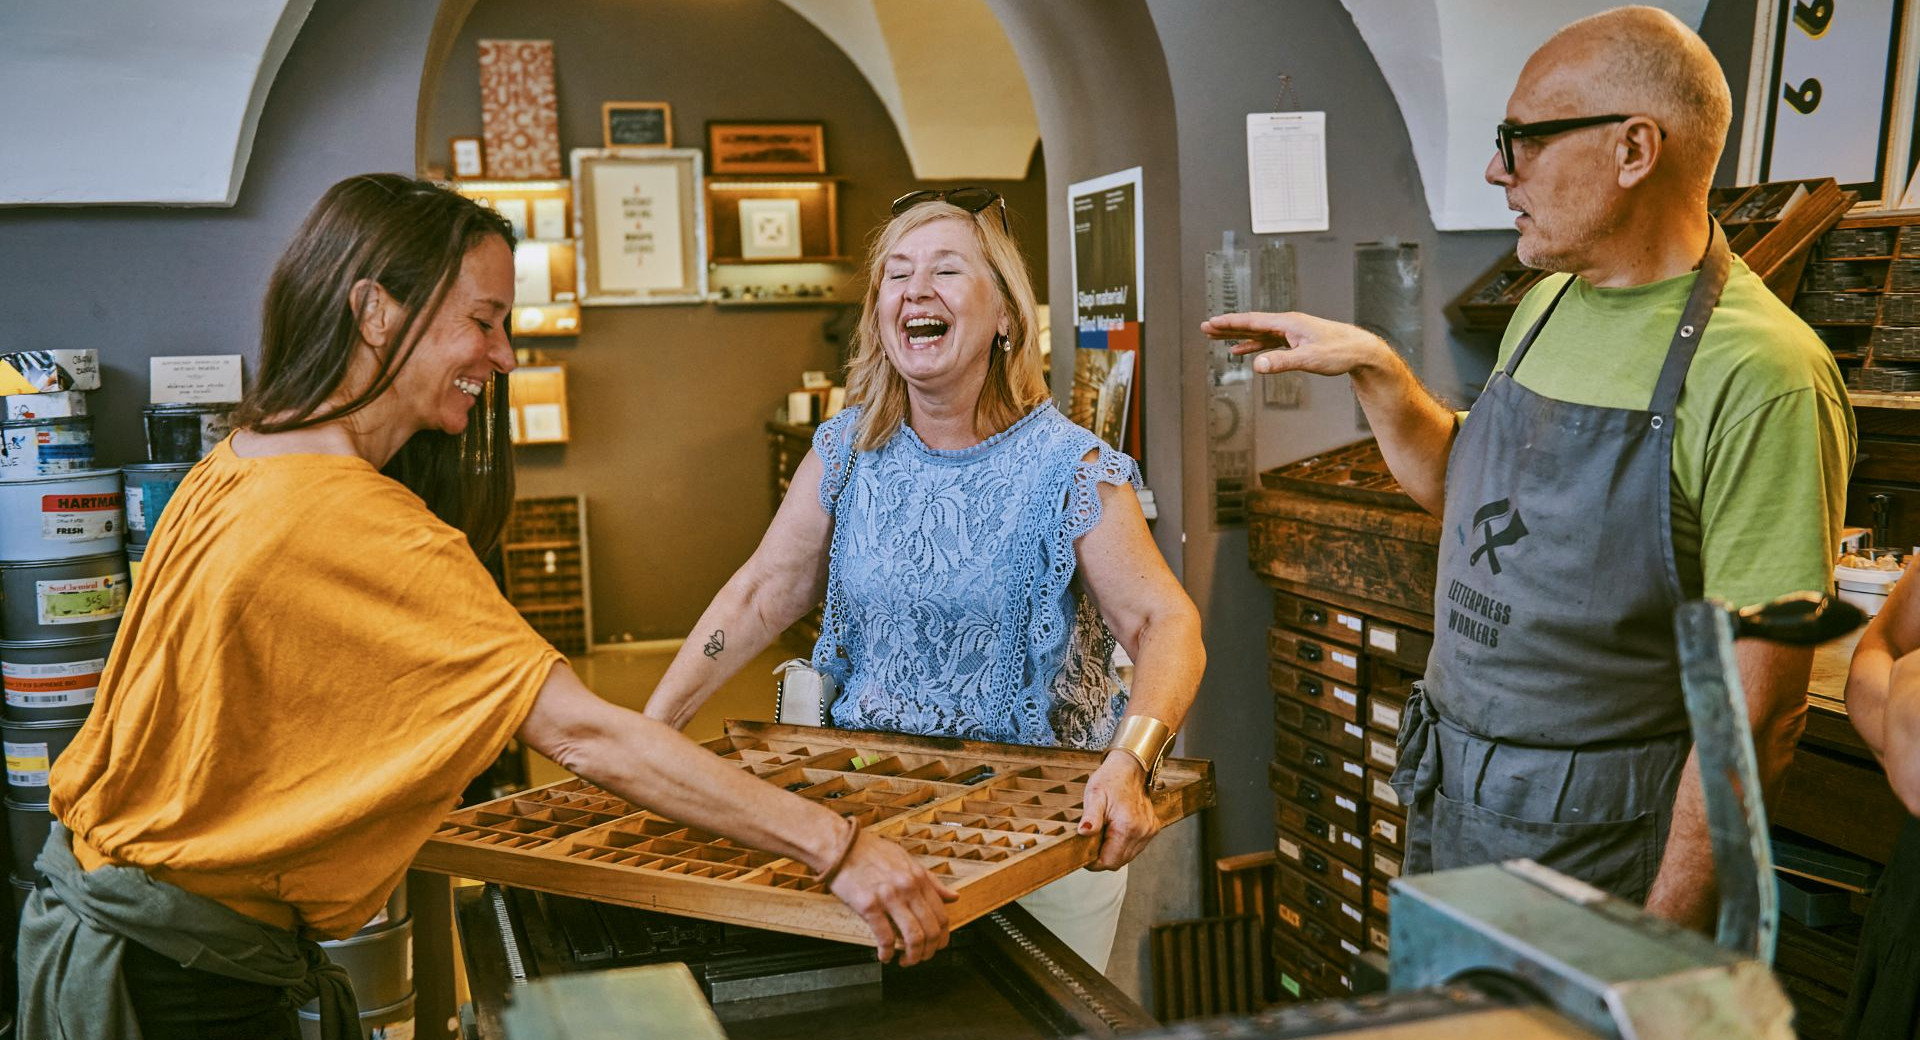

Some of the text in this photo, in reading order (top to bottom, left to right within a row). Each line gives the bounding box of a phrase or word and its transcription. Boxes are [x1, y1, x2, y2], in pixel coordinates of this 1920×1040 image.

[56, 526, 84, 535] FRESH
[48, 580, 98, 592] SunChemical
[1448, 578, 1512, 625] LETTERPRESS
[1448, 608, 1499, 648] WORKERS
